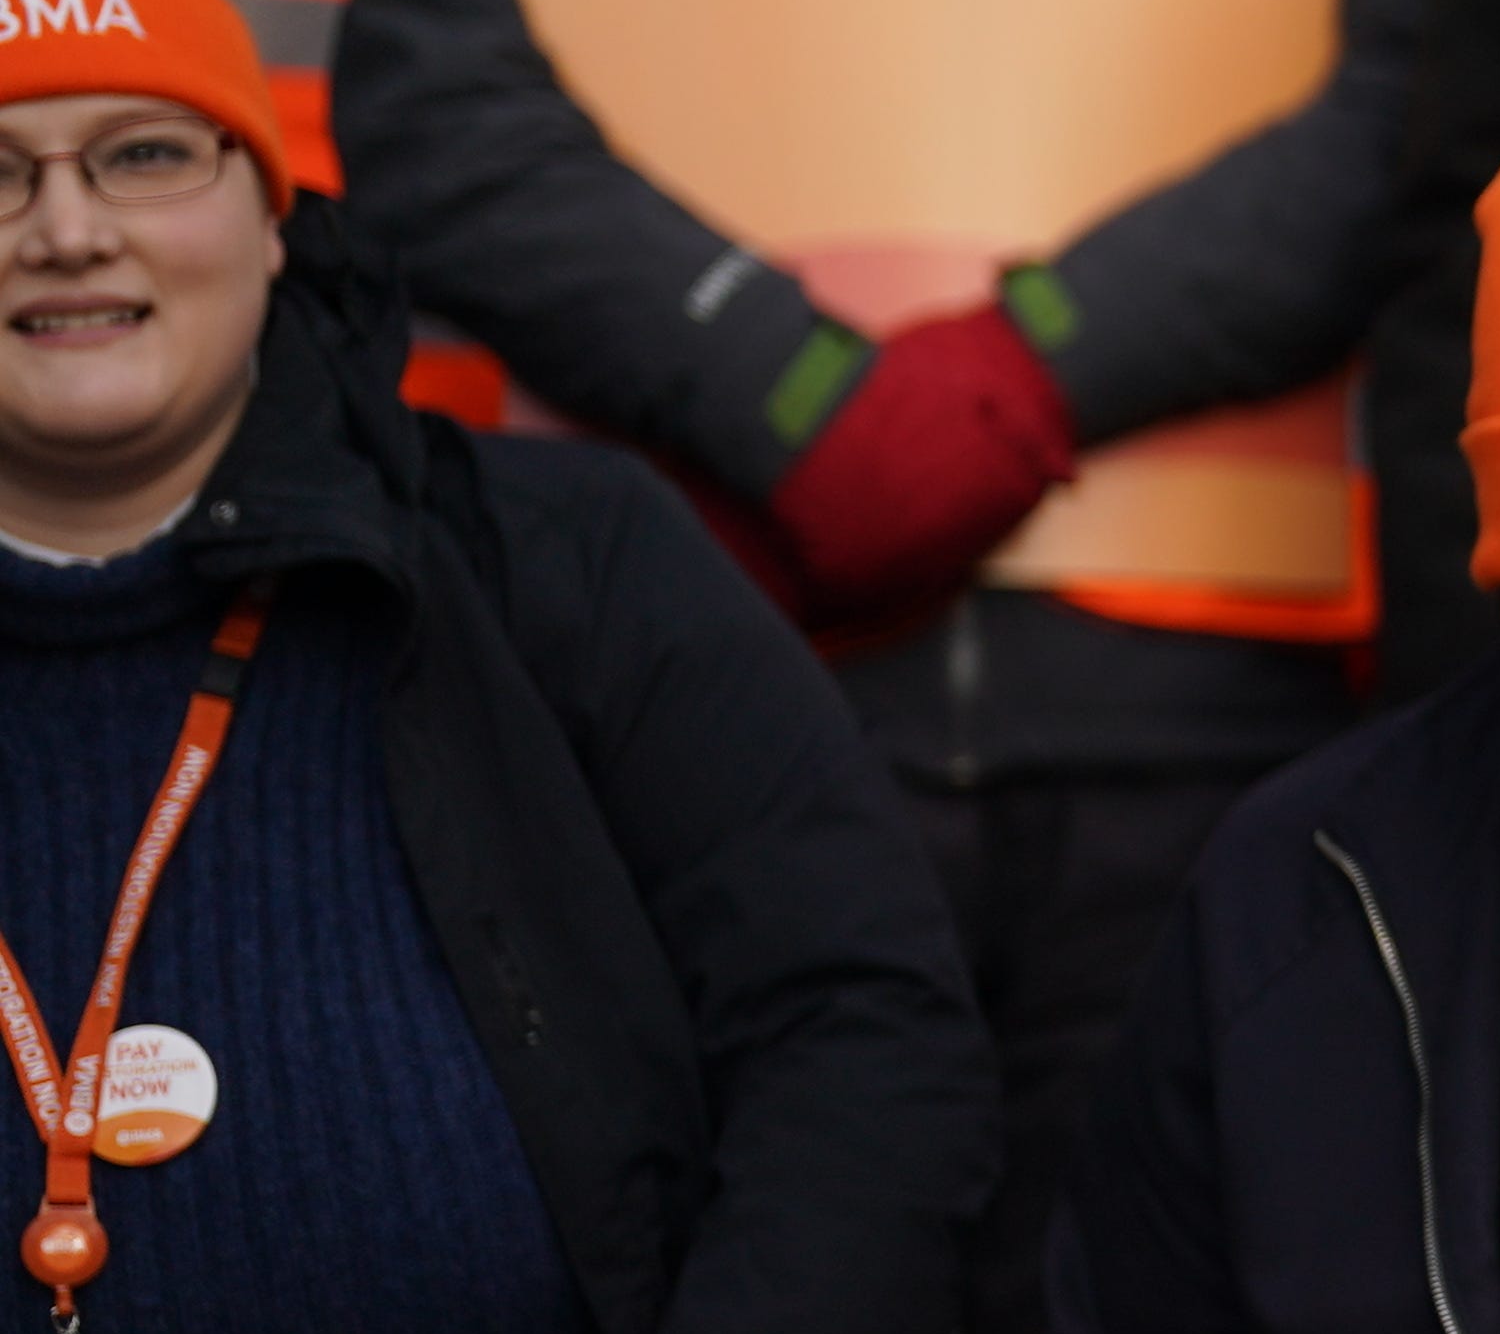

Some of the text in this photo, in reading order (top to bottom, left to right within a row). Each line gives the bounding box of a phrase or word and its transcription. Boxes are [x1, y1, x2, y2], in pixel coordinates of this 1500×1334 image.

[166, 744, 211, 801] NOW
[0, 951, 51, 1084] ORATION
[115, 1039, 164, 1062] PAY
[110, 1077, 172, 1101] NOW
